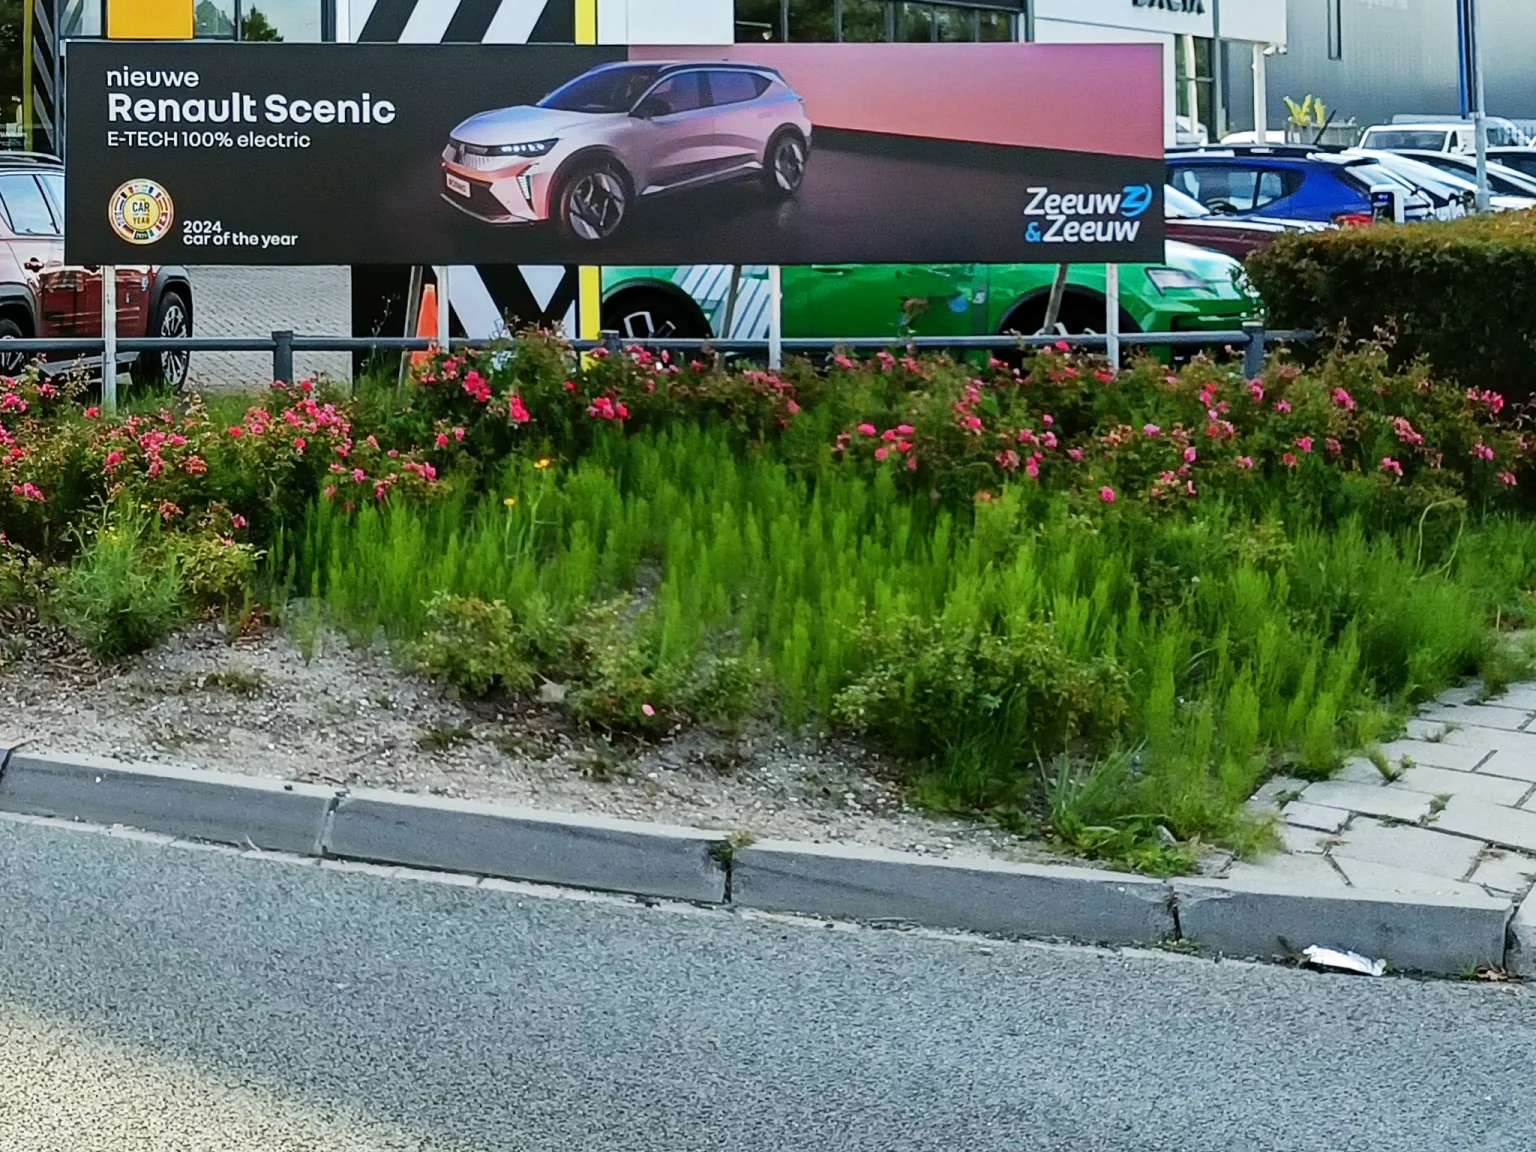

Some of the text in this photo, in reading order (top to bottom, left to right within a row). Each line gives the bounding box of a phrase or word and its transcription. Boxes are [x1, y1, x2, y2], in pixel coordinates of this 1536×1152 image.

[106, 66, 199, 88] nieuwe
[107, 92, 396, 124] Renault Scenic
[107, 131, 311, 148] E-TECH 100% electric
[132, 202, 150, 212] CAR
[1023, 186, 1121, 215] Zeeuw
[183, 220, 222, 234] 2024
[1025, 214, 1140, 243] & Zeeuw
[183, 232, 299, 248] car of the year
